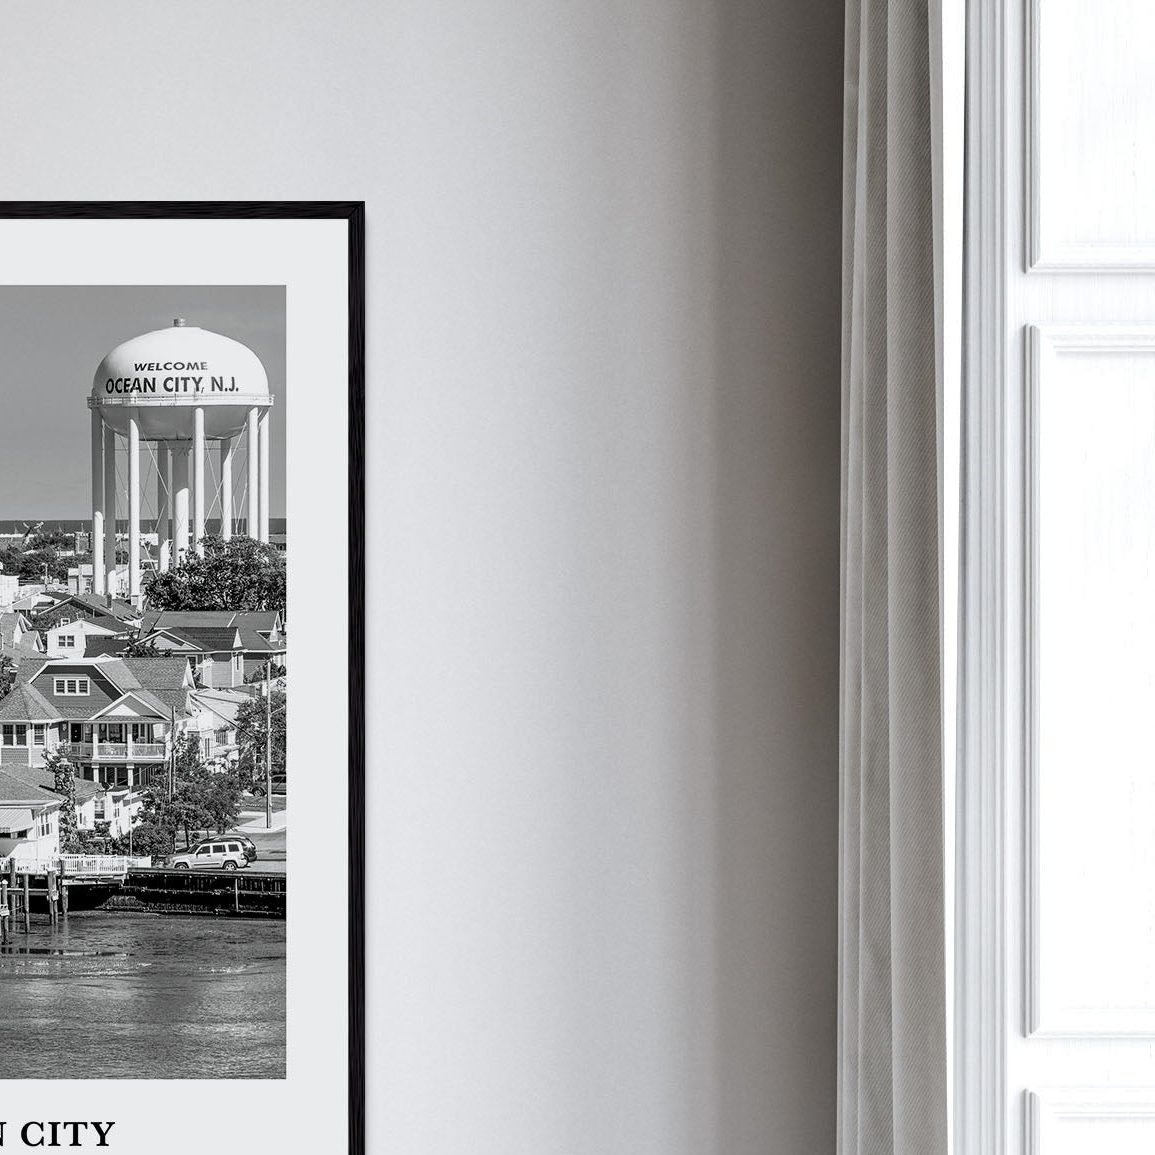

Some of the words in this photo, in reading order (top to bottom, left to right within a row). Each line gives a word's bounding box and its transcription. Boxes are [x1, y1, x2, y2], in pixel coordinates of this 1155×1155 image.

[134, 361, 208, 372] WELCOME
[105, 377, 156, 394] OCEAN
[162, 376, 204, 393] CITY,
[211, 376, 240, 392] N.J.
[20, 1121, 116, 1147] CITY
